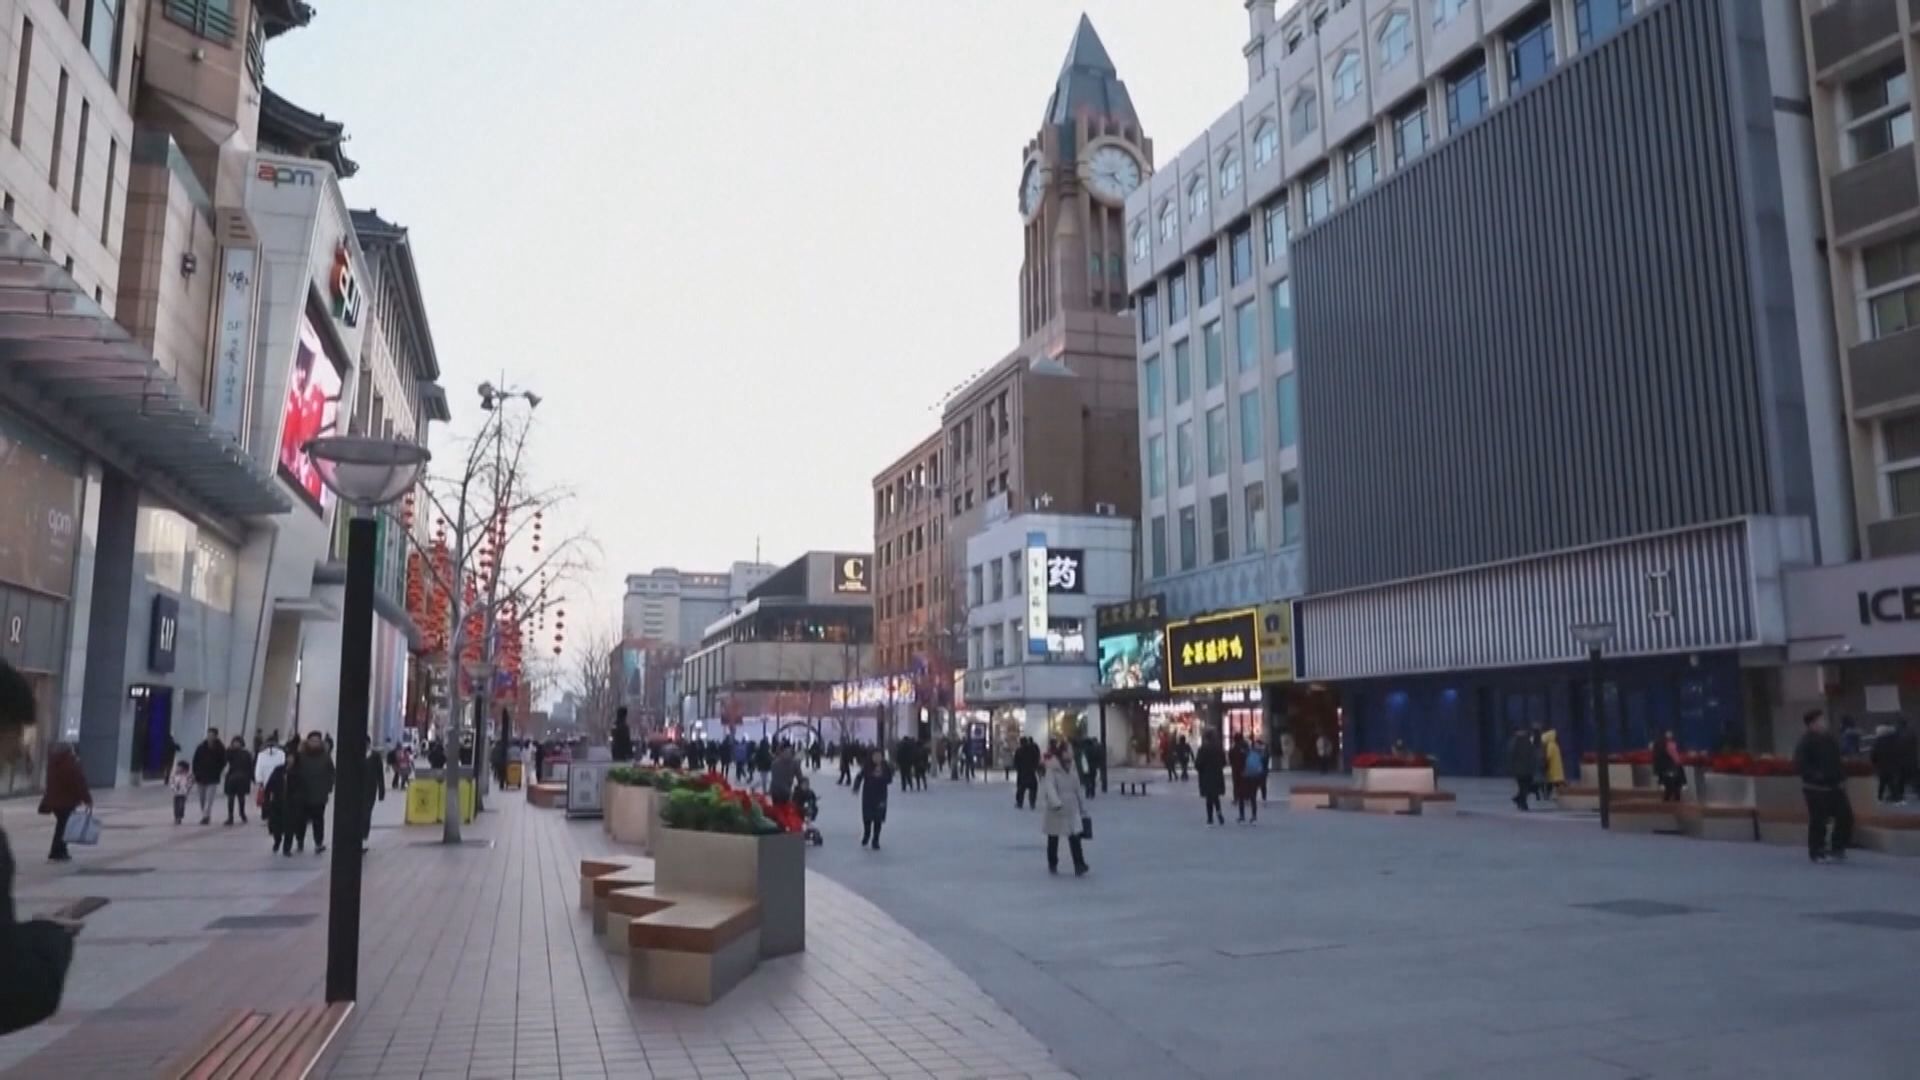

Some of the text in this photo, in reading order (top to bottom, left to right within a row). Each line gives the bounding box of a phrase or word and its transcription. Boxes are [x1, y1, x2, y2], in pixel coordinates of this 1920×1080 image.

[258, 163, 314, 188] apm
[844, 557, 863, 580] C
[1047, 556, 1077, 588] 药
